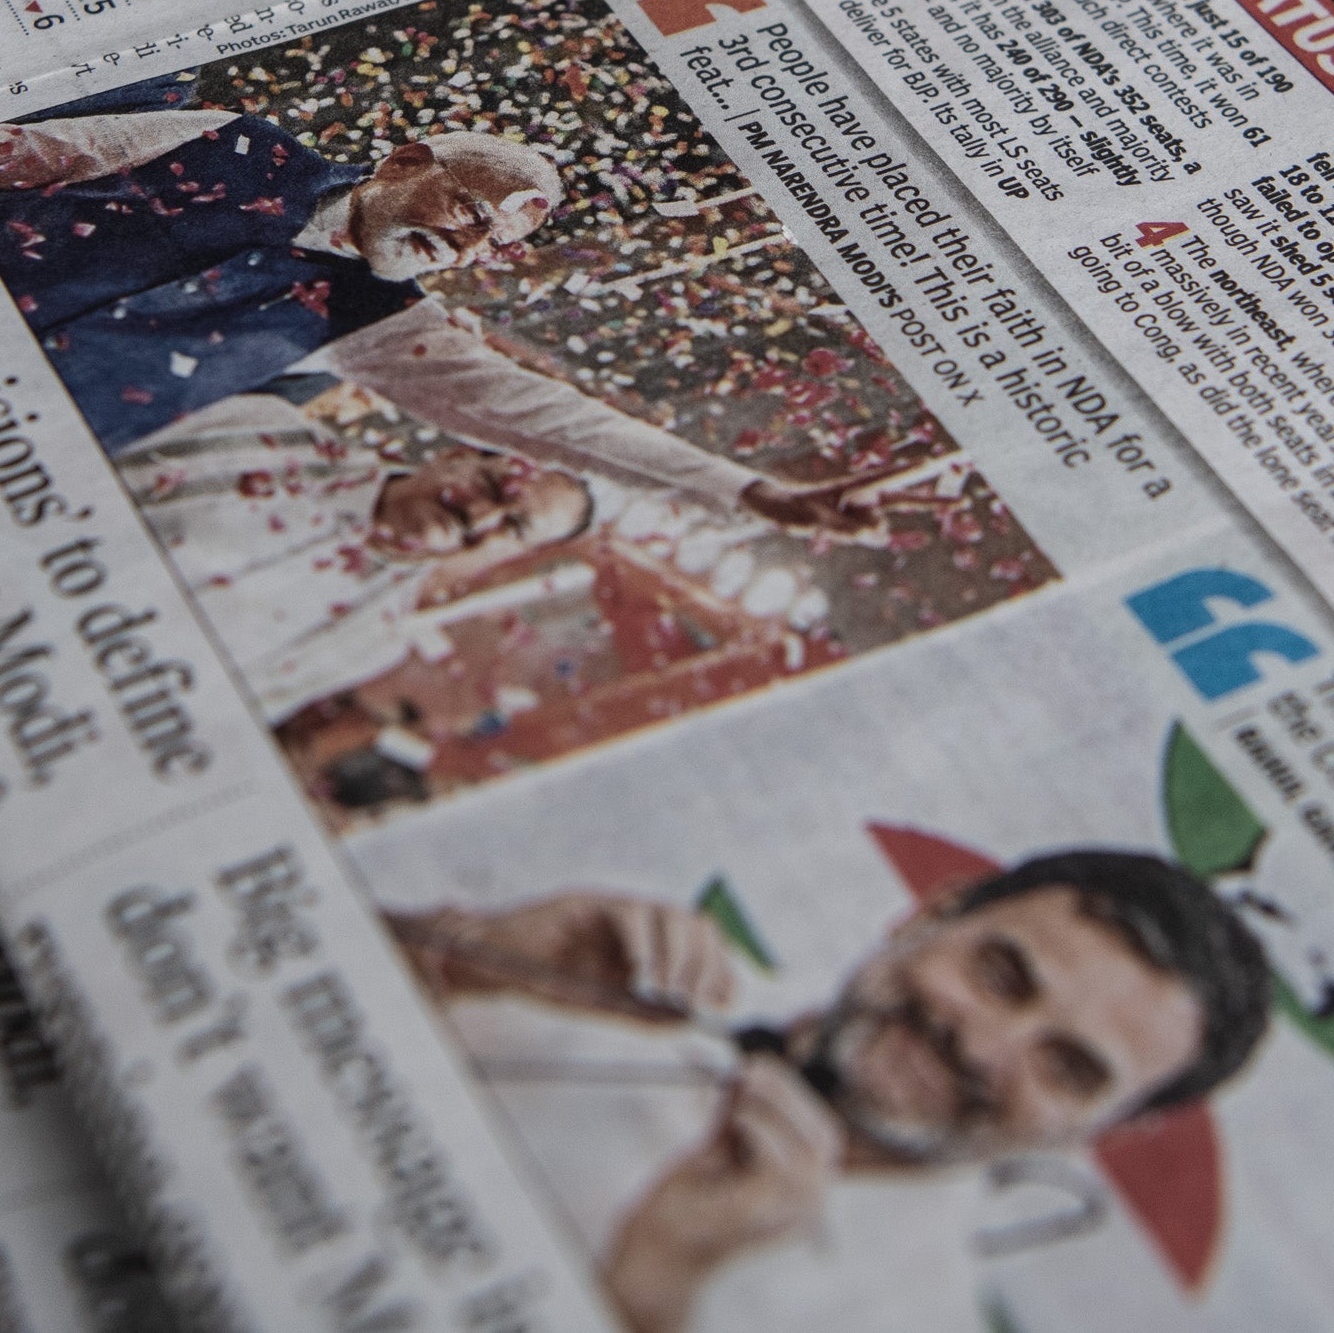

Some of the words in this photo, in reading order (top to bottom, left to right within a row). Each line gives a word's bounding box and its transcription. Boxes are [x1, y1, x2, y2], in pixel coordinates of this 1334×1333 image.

[216, 26, 288, 55] Photos:
[286, 14, 339, 35] Tarun
[995, 39, 1032, 66] 240
[1022, 67, 1052, 84] of
[1036, 83, 1074, 112] 290
[1078, 131, 1141, 187] slightly
[678, 45, 734, 111] feat...
[736, 121, 776, 151] PM
[760, 149, 849, 245] NARENDRA
[888, 308, 946, 357] POST
[932, 360, 970, 390] ON
[956, 389, 983, 408] X
[1250, 176, 1309, 223] failed
[1296, 220, 1321, 241] to
[717, 34, 770, 72] 3rd
[749, 75, 870, 203] consecutive
[858, 203, 931, 268] time!
[913, 266, 968, 323] This
[955, 321, 990, 348] is
[978, 350, 1006, 371] a
[995, 367, 1090, 469] historic
[755, 22, 829, 97] People
[816, 95, 876, 152] have
[857, 152, 952, 229] placed
[931, 228, 994, 285] their
[980, 288, 1045, 349] faith
[1031, 347, 1067, 377] in
[1056, 375, 1119, 435] NDA
[1106, 434, 1155, 473] for
[1141, 478, 1171, 501] a
[1269, 236, 1323, 276] shed
[1309, 273, 1334, 288] 5
[39, 538, 105, 599] to
[74, 605, 210, 777] define
